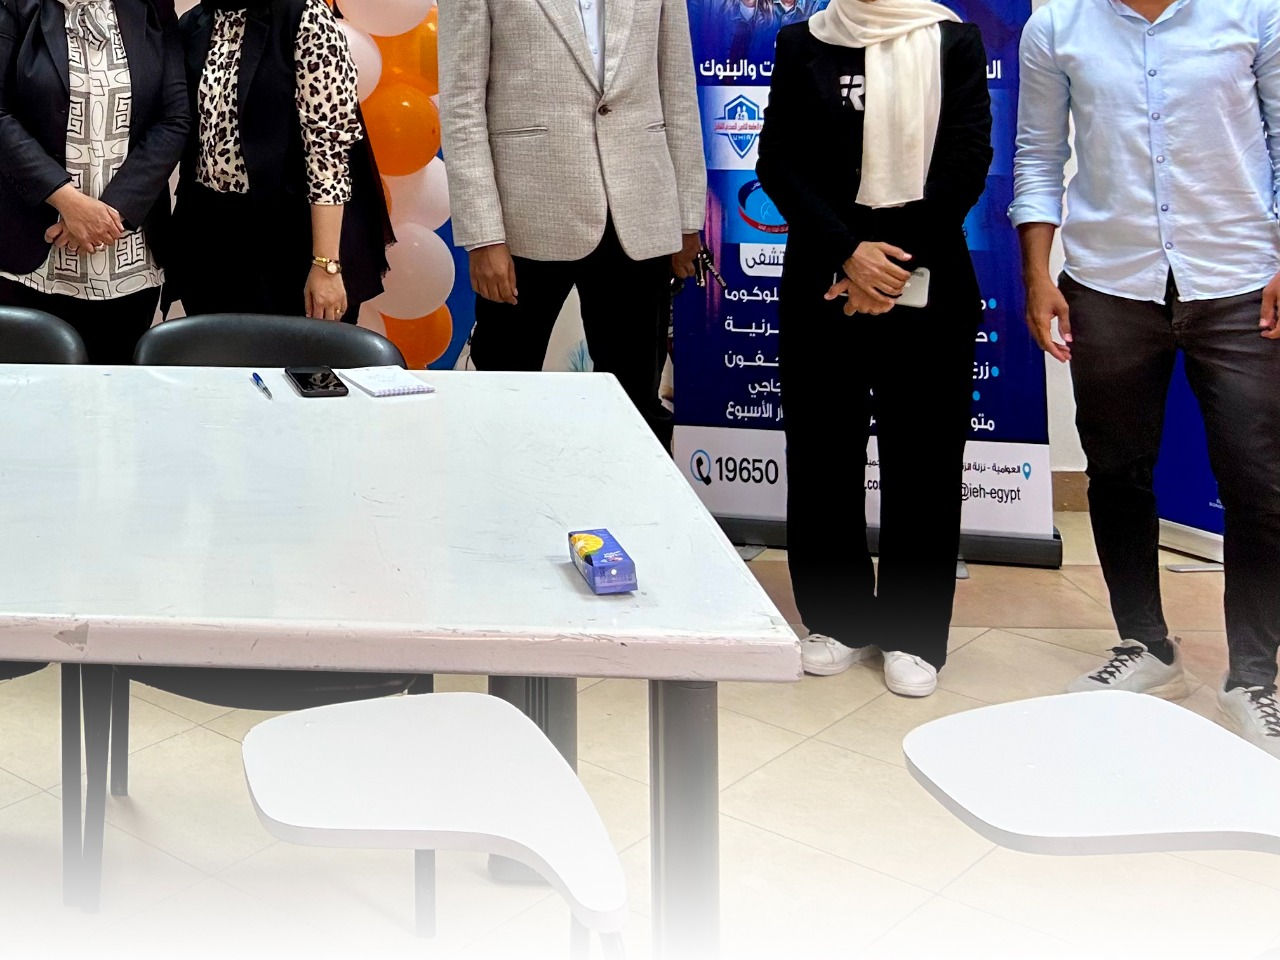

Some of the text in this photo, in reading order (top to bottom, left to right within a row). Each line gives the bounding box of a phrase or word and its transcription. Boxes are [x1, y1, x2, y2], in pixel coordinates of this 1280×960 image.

[700, 58, 757, 80] والبنوك
[726, 400, 773, 421] الأسبوع
[715, 456, 779, 485] 19650
